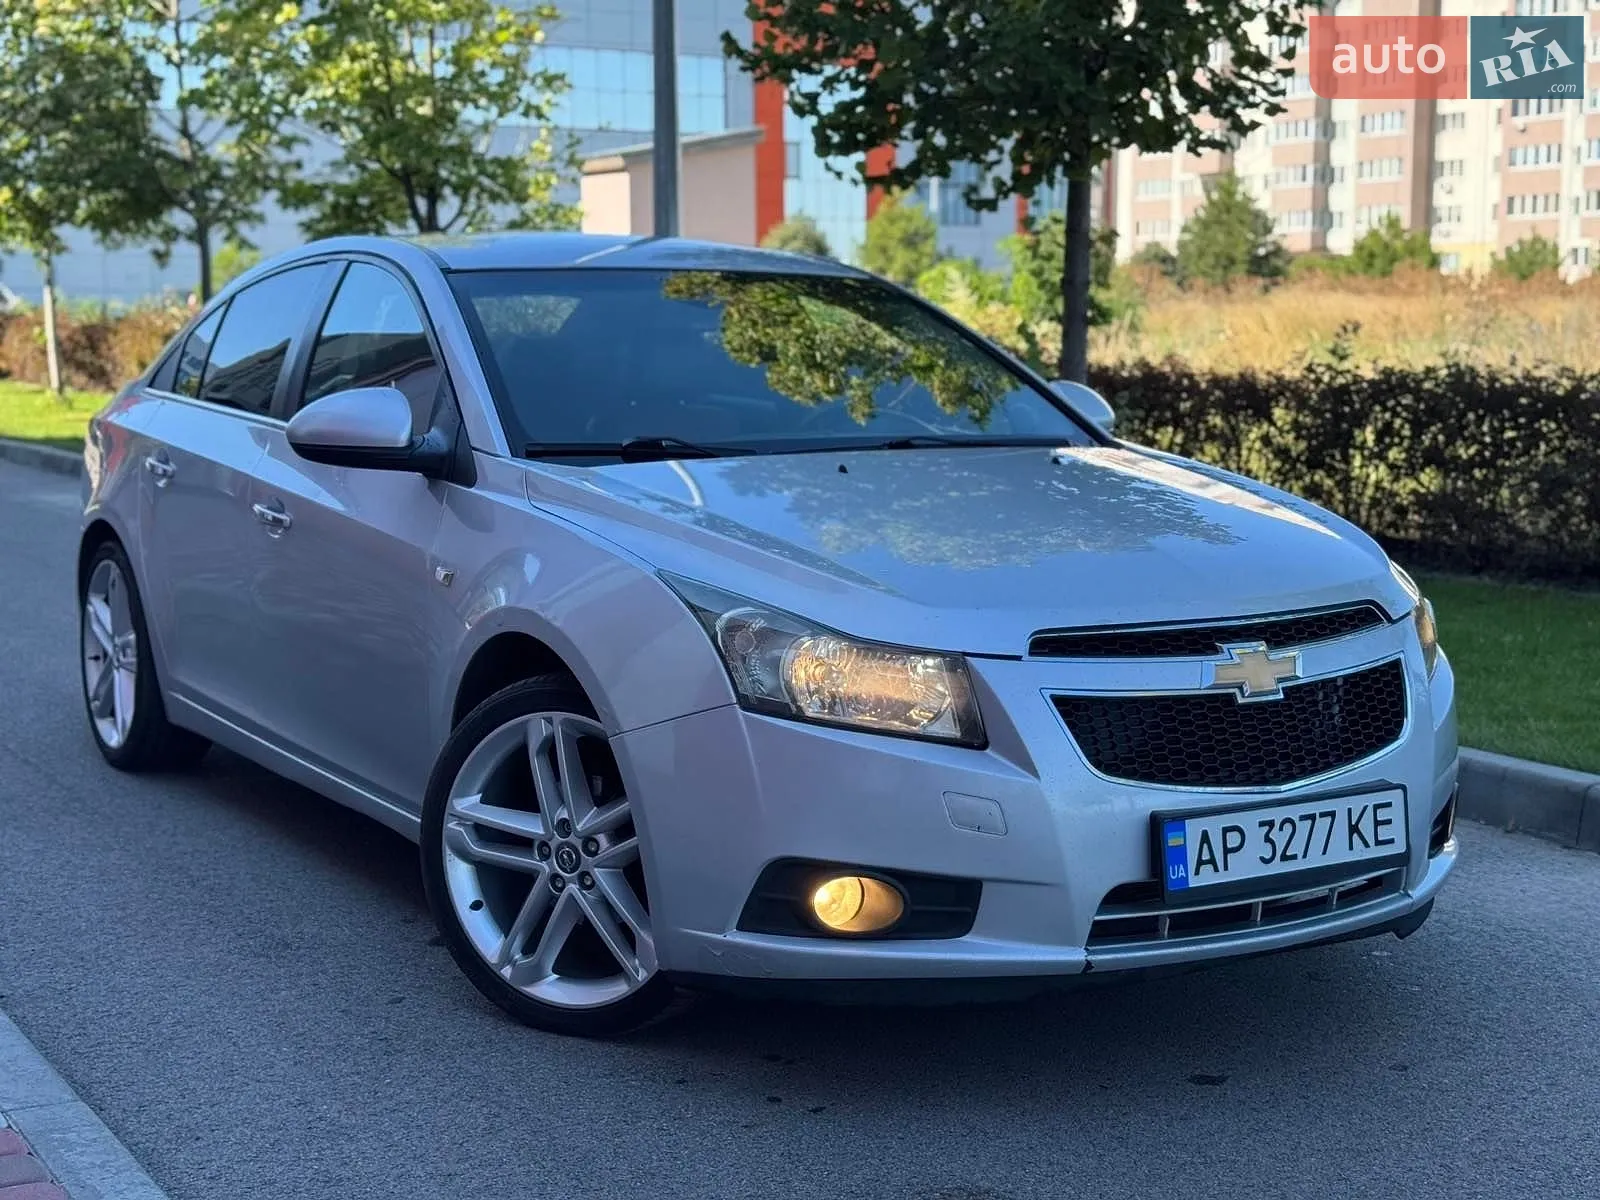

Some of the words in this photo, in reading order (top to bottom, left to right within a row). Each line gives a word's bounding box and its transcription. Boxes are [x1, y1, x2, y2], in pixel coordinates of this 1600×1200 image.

[1194, 824, 1246, 876] AP
[1258, 810, 1337, 865] 3277
[1347, 801, 1396, 851] KE
[1169, 864, 1187, 879] UA
